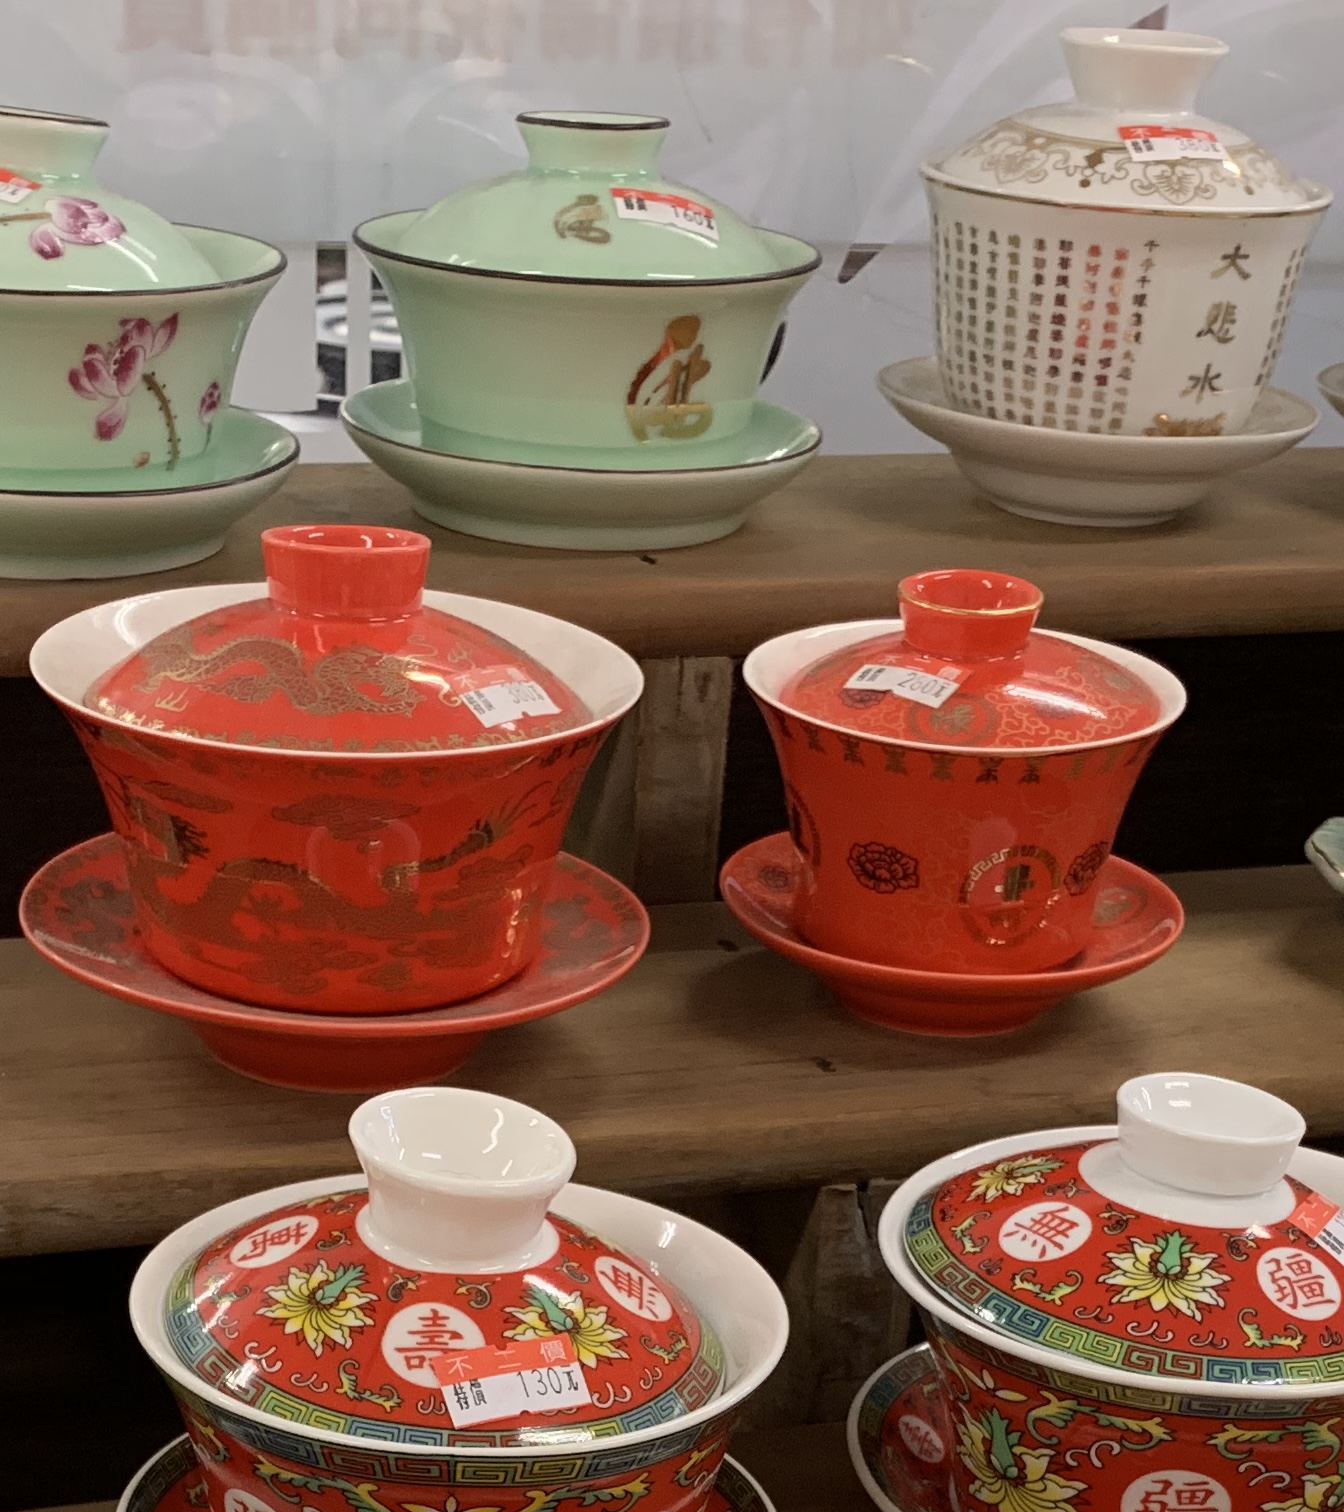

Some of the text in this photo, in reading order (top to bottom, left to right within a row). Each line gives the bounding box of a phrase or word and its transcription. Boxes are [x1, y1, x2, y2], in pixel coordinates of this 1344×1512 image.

[1179, 243, 1252, 404] 大悲水
[1004, 1204, 1081, 1261] 無
[1264, 1253, 1338, 1313] 疆
[393, 1307, 466, 1372] 壽
[445, 1338, 569, 1379] 不二價
[452, 1365, 580, 1412] 特價 130元
